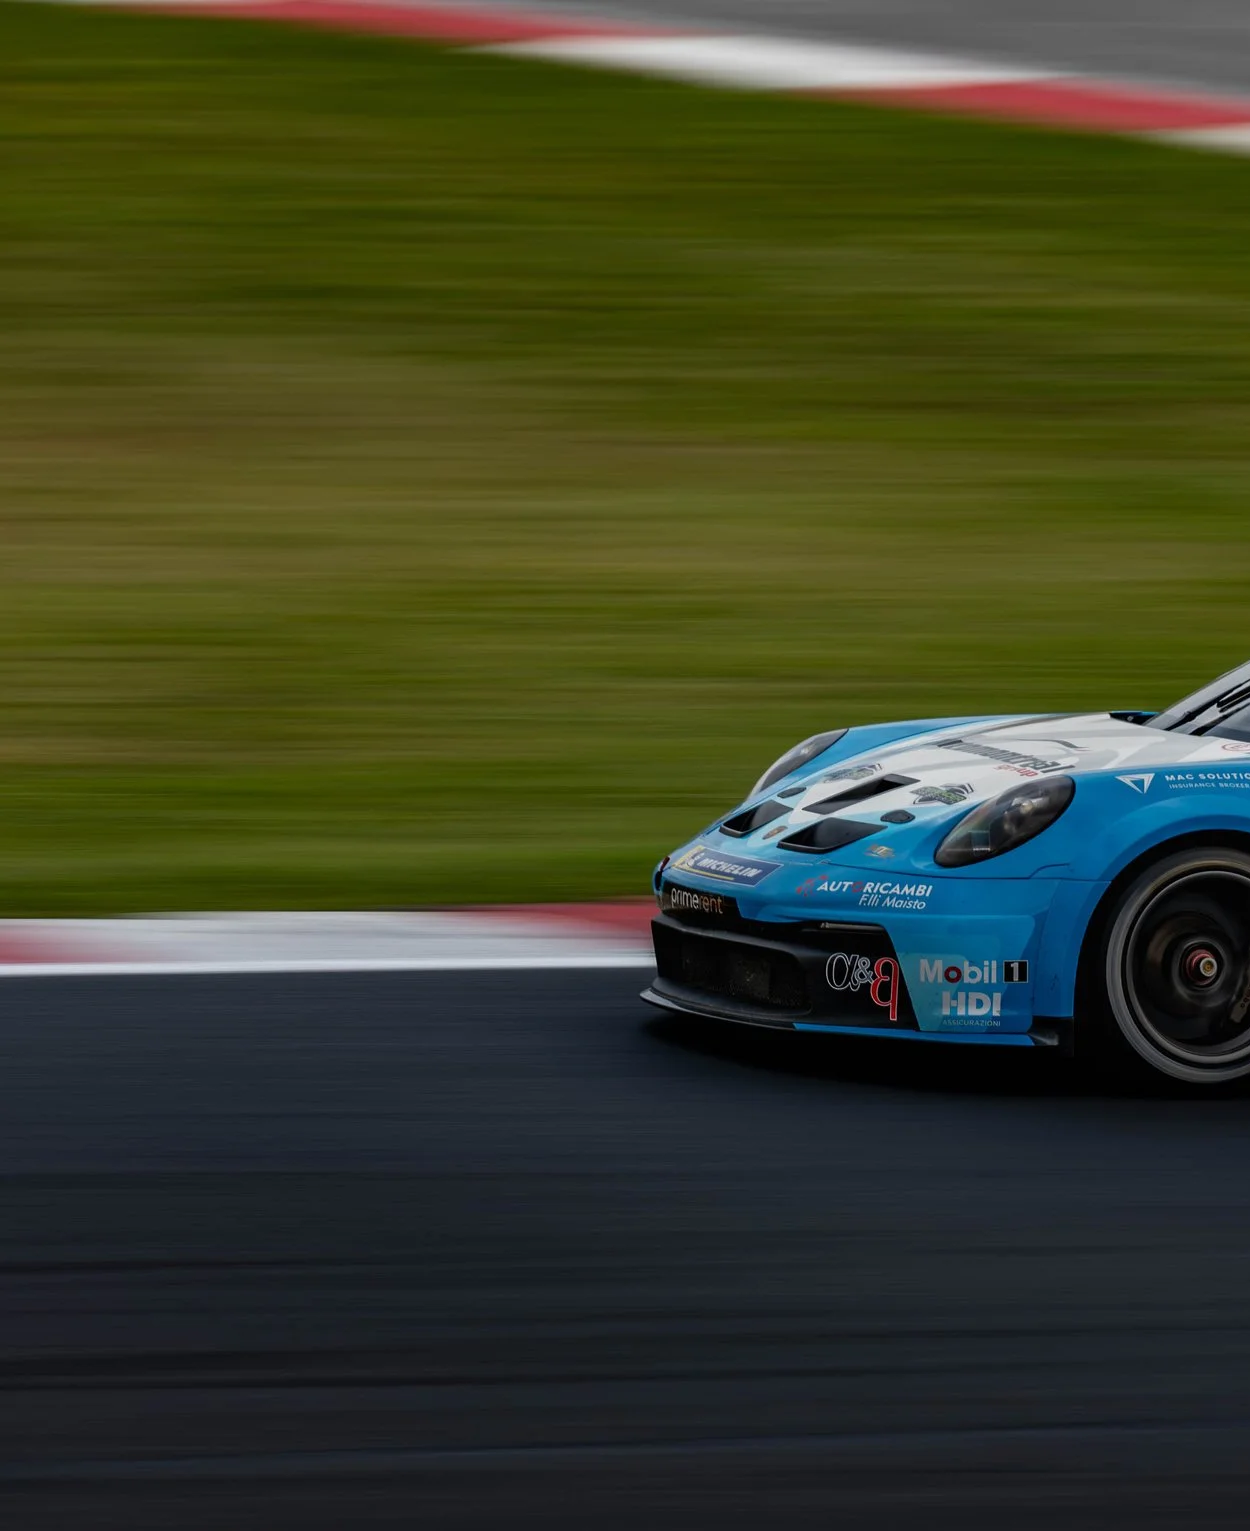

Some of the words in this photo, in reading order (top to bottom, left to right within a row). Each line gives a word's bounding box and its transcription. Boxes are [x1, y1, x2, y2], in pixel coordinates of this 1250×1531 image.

[1164, 773, 1194, 781] MAC
[697, 858, 763, 878] MICHELIN
[816, 880, 933, 897] AUTORICAMBI
[671, 887, 723, 914] primerent
[882, 896, 926, 910] Maisto
[920, 959, 996, 984] Mobil
[942, 991, 1001, 1016] HDI
[942, 1019, 1001, 1027] ASSICURAZIONI
